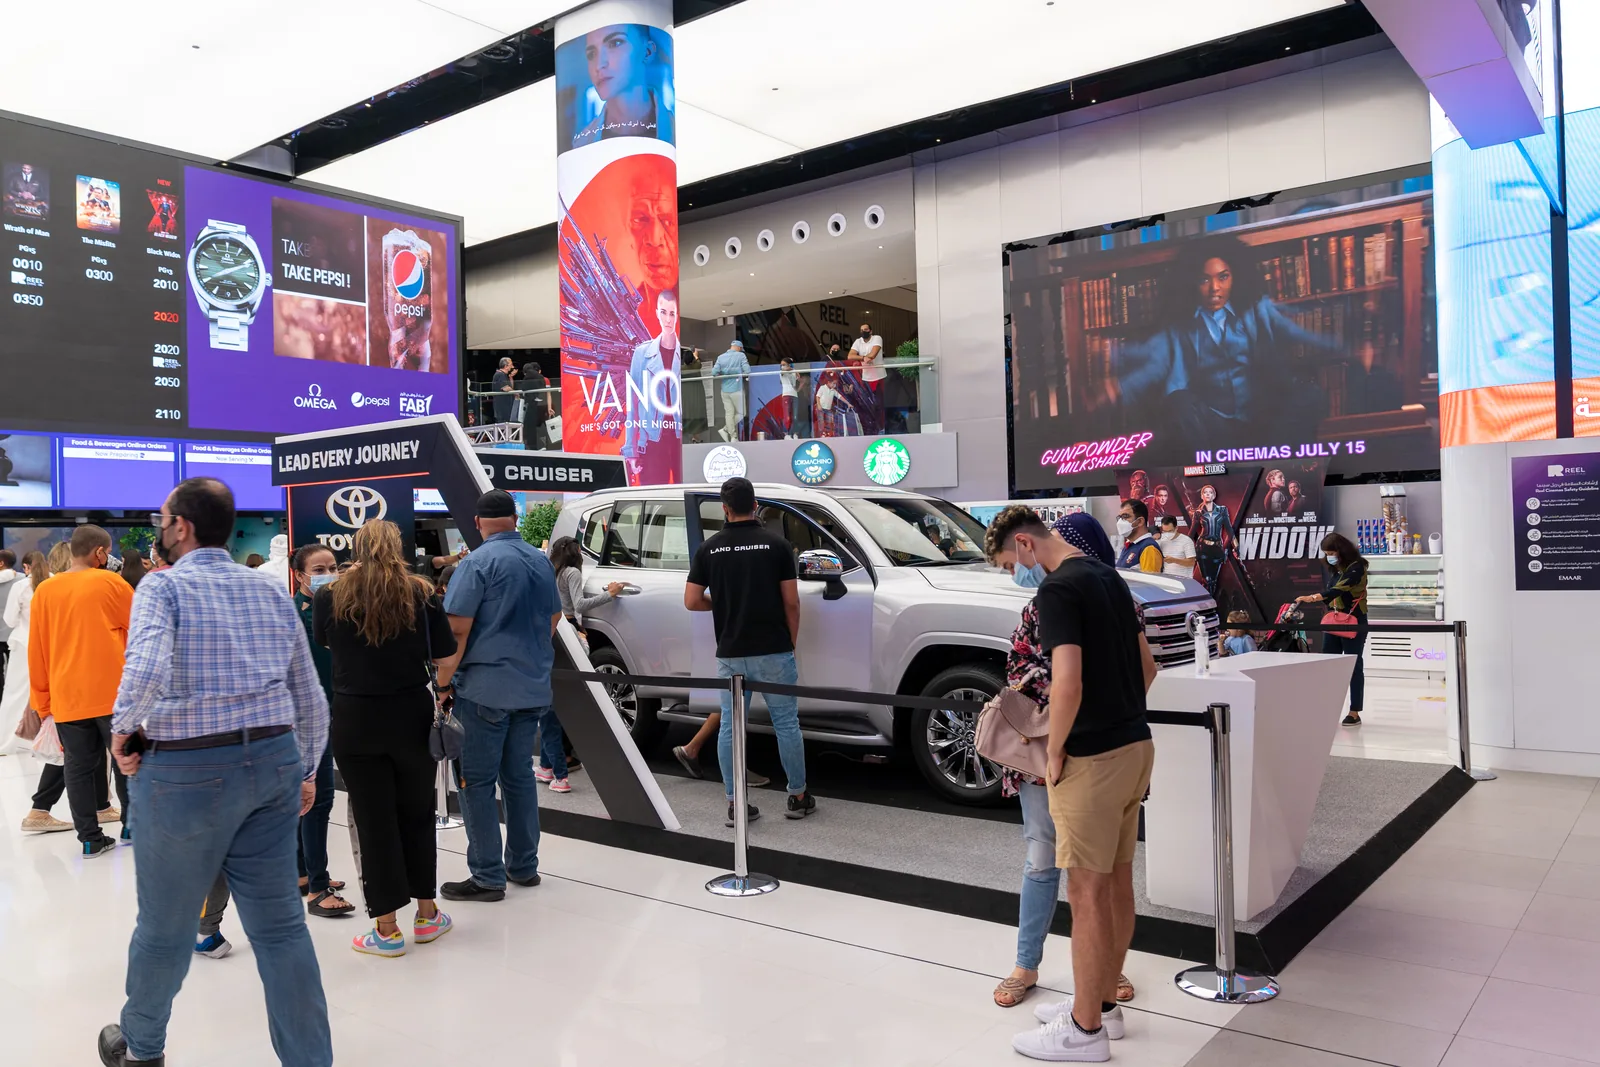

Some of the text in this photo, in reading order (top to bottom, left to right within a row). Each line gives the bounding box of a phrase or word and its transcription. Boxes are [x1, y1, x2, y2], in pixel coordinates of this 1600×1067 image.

[4, 224, 25, 234] Wrath
[35, 228, 50, 237] Man
[82, 236, 116, 248] The Misfits
[147, 248, 163, 256] Black
[13, 258, 43, 271] 0010
[85, 269, 113, 281] 0300
[281, 263, 313, 282] TAKE
[153, 279, 179, 291] 2010
[13, 293, 43, 306] 0350
[394, 303, 424, 318] pepsi
[820, 303, 849, 326] REEL
[154, 312, 179, 323] 2020
[154, 344, 180, 355] 2020
[154, 376, 180, 388] 2050
[294, 396, 337, 410] OMEGA
[365, 396, 390, 407] pepsi
[155, 409, 181, 420] 2110
[580, 423, 600, 432] SHE'S
[603, 420, 620, 430] GOT
[624, 420, 647, 428] ONE
[651, 420, 676, 430] NIGHT
[94, 440, 126, 448] Beverages
[1041, 432, 1153, 466] GUNPOWDER
[278, 440, 420, 472] LEAD EVERY JOURNEY
[1195, 440, 1365, 464] IN CINEMAS JULY 15
[1056, 451, 1134, 475] MILKSHAKE
[1185, 464, 1225, 475] MARVEL STUDIOS
[504, 465, 594, 482] CRUISER
[1239, 525, 1335, 560] WIDOW
